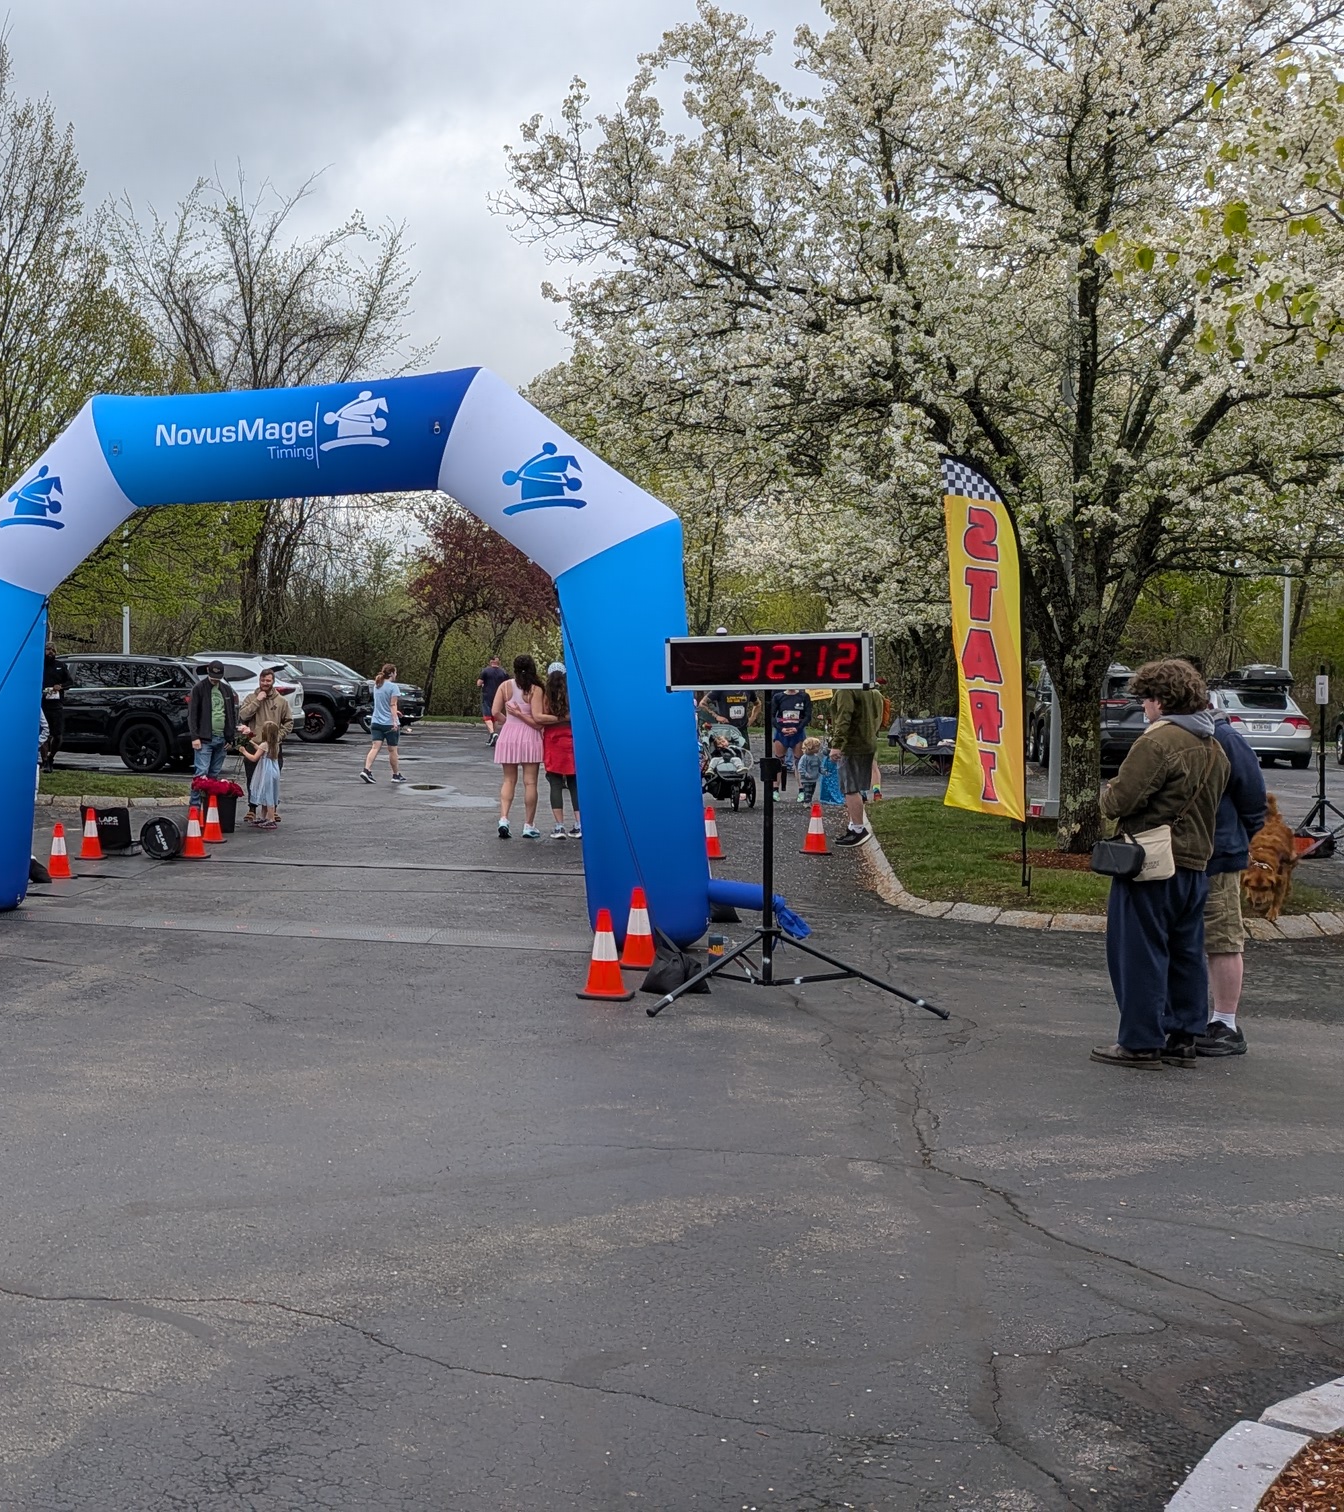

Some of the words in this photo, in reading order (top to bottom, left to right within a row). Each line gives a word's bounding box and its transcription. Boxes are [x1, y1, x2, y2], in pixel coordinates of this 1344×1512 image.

[155, 418, 313, 447] NovusMage
[267, 445, 314, 460] Timing
[739, 643, 858, 680] 32:12
